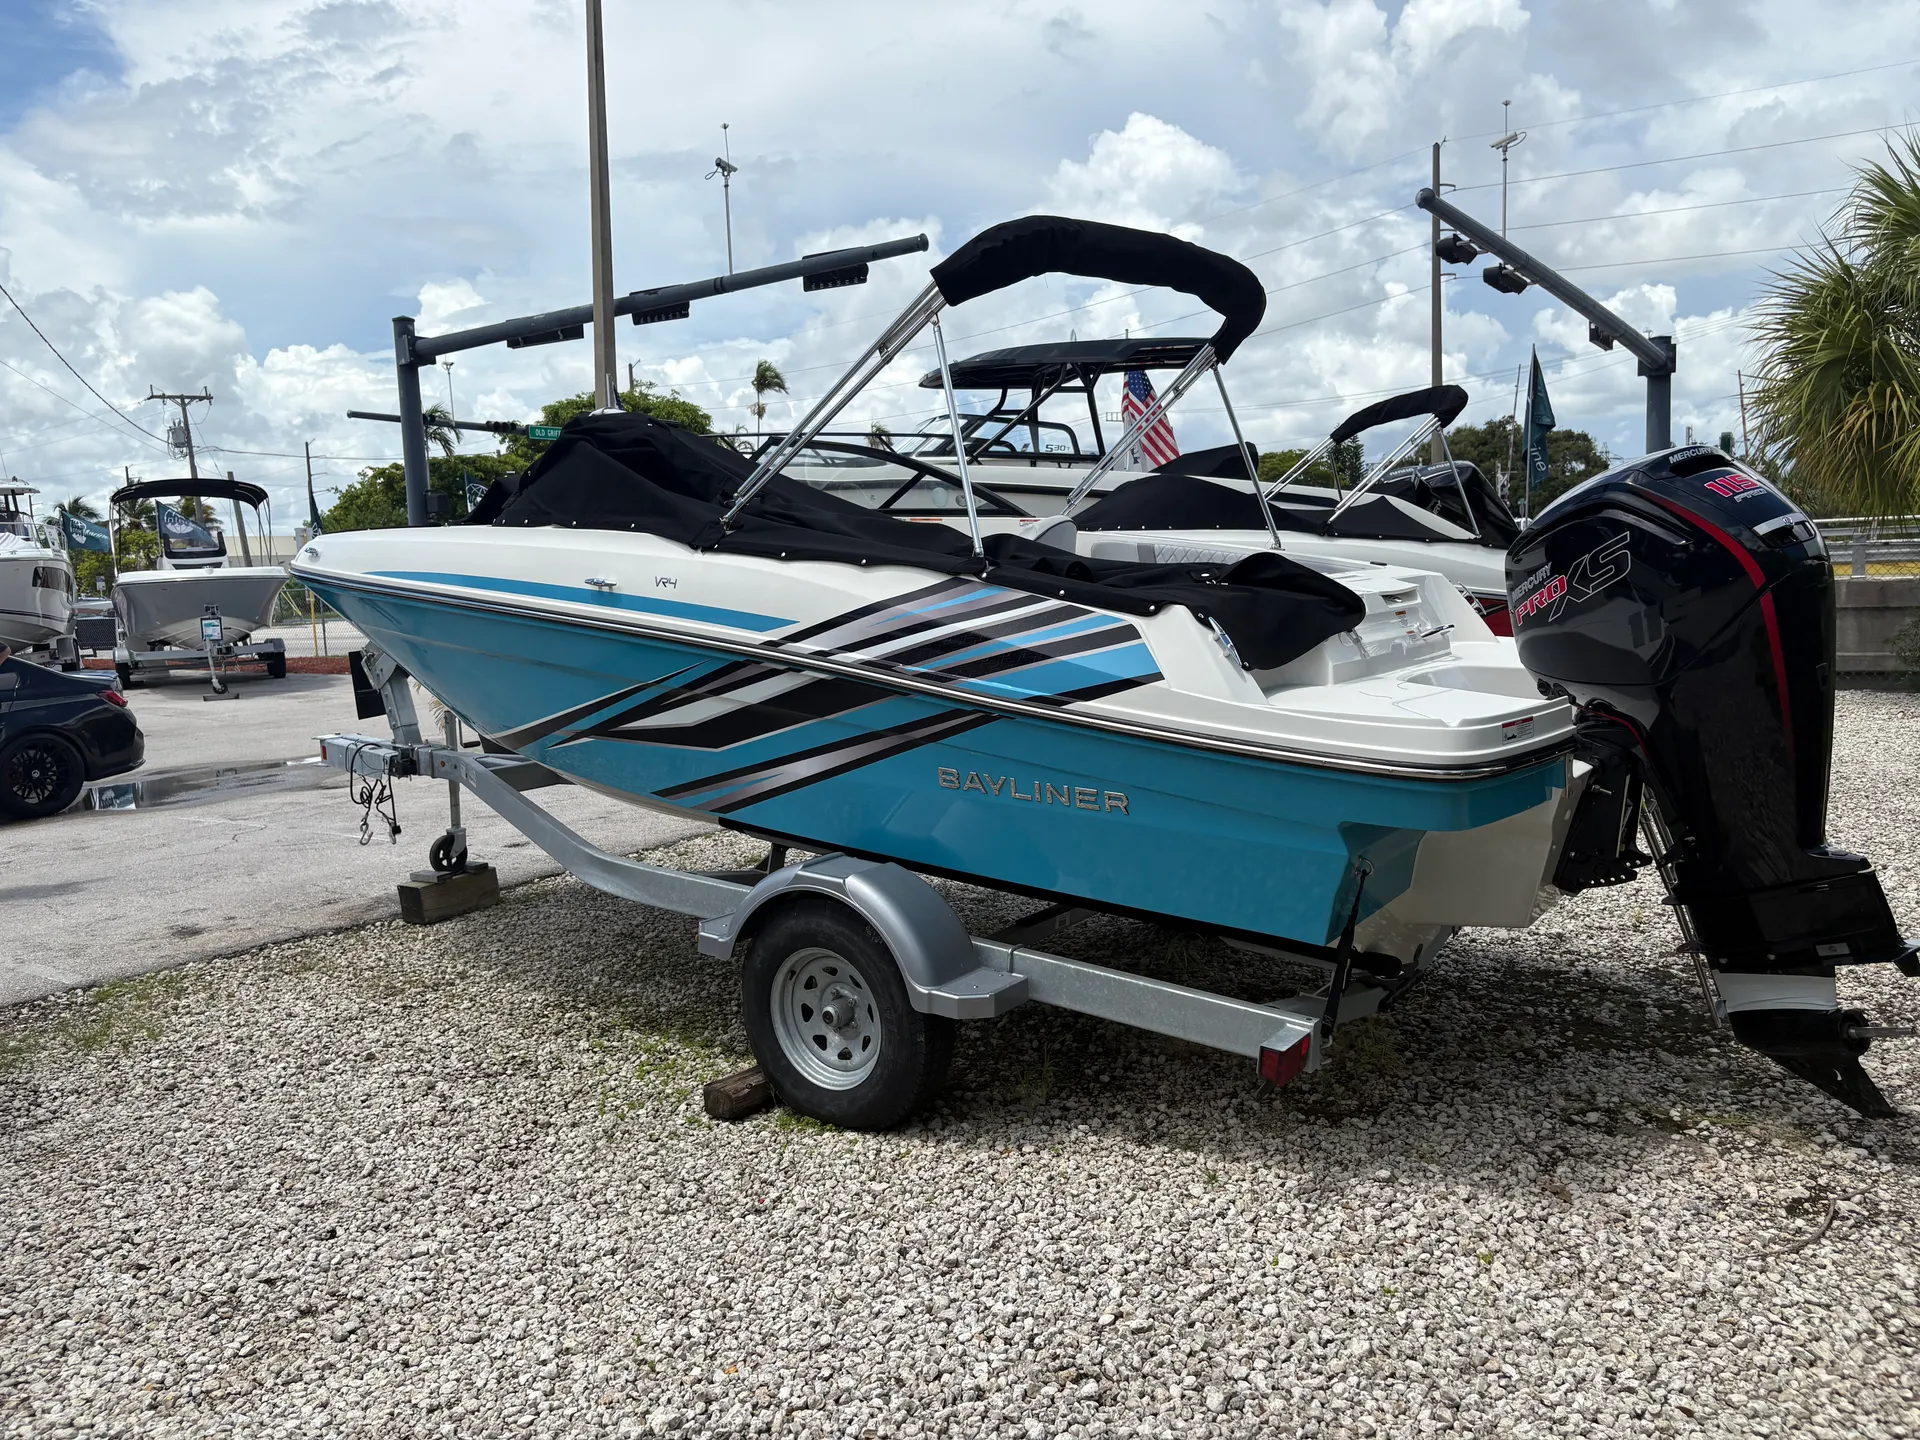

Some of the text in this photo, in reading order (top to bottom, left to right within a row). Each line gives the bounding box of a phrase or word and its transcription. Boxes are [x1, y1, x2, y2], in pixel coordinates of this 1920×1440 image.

[535, 428, 546, 437] OLD
[1668, 446, 1713, 464] MERCURY
[1703, 473, 1760, 498] 115
[654, 576, 678, 590] VR4
[1511, 561, 1553, 603] MERCURY
[1515, 530, 1632, 626] PRO XS
[937, 766, 1130, 816] BAYLINER
